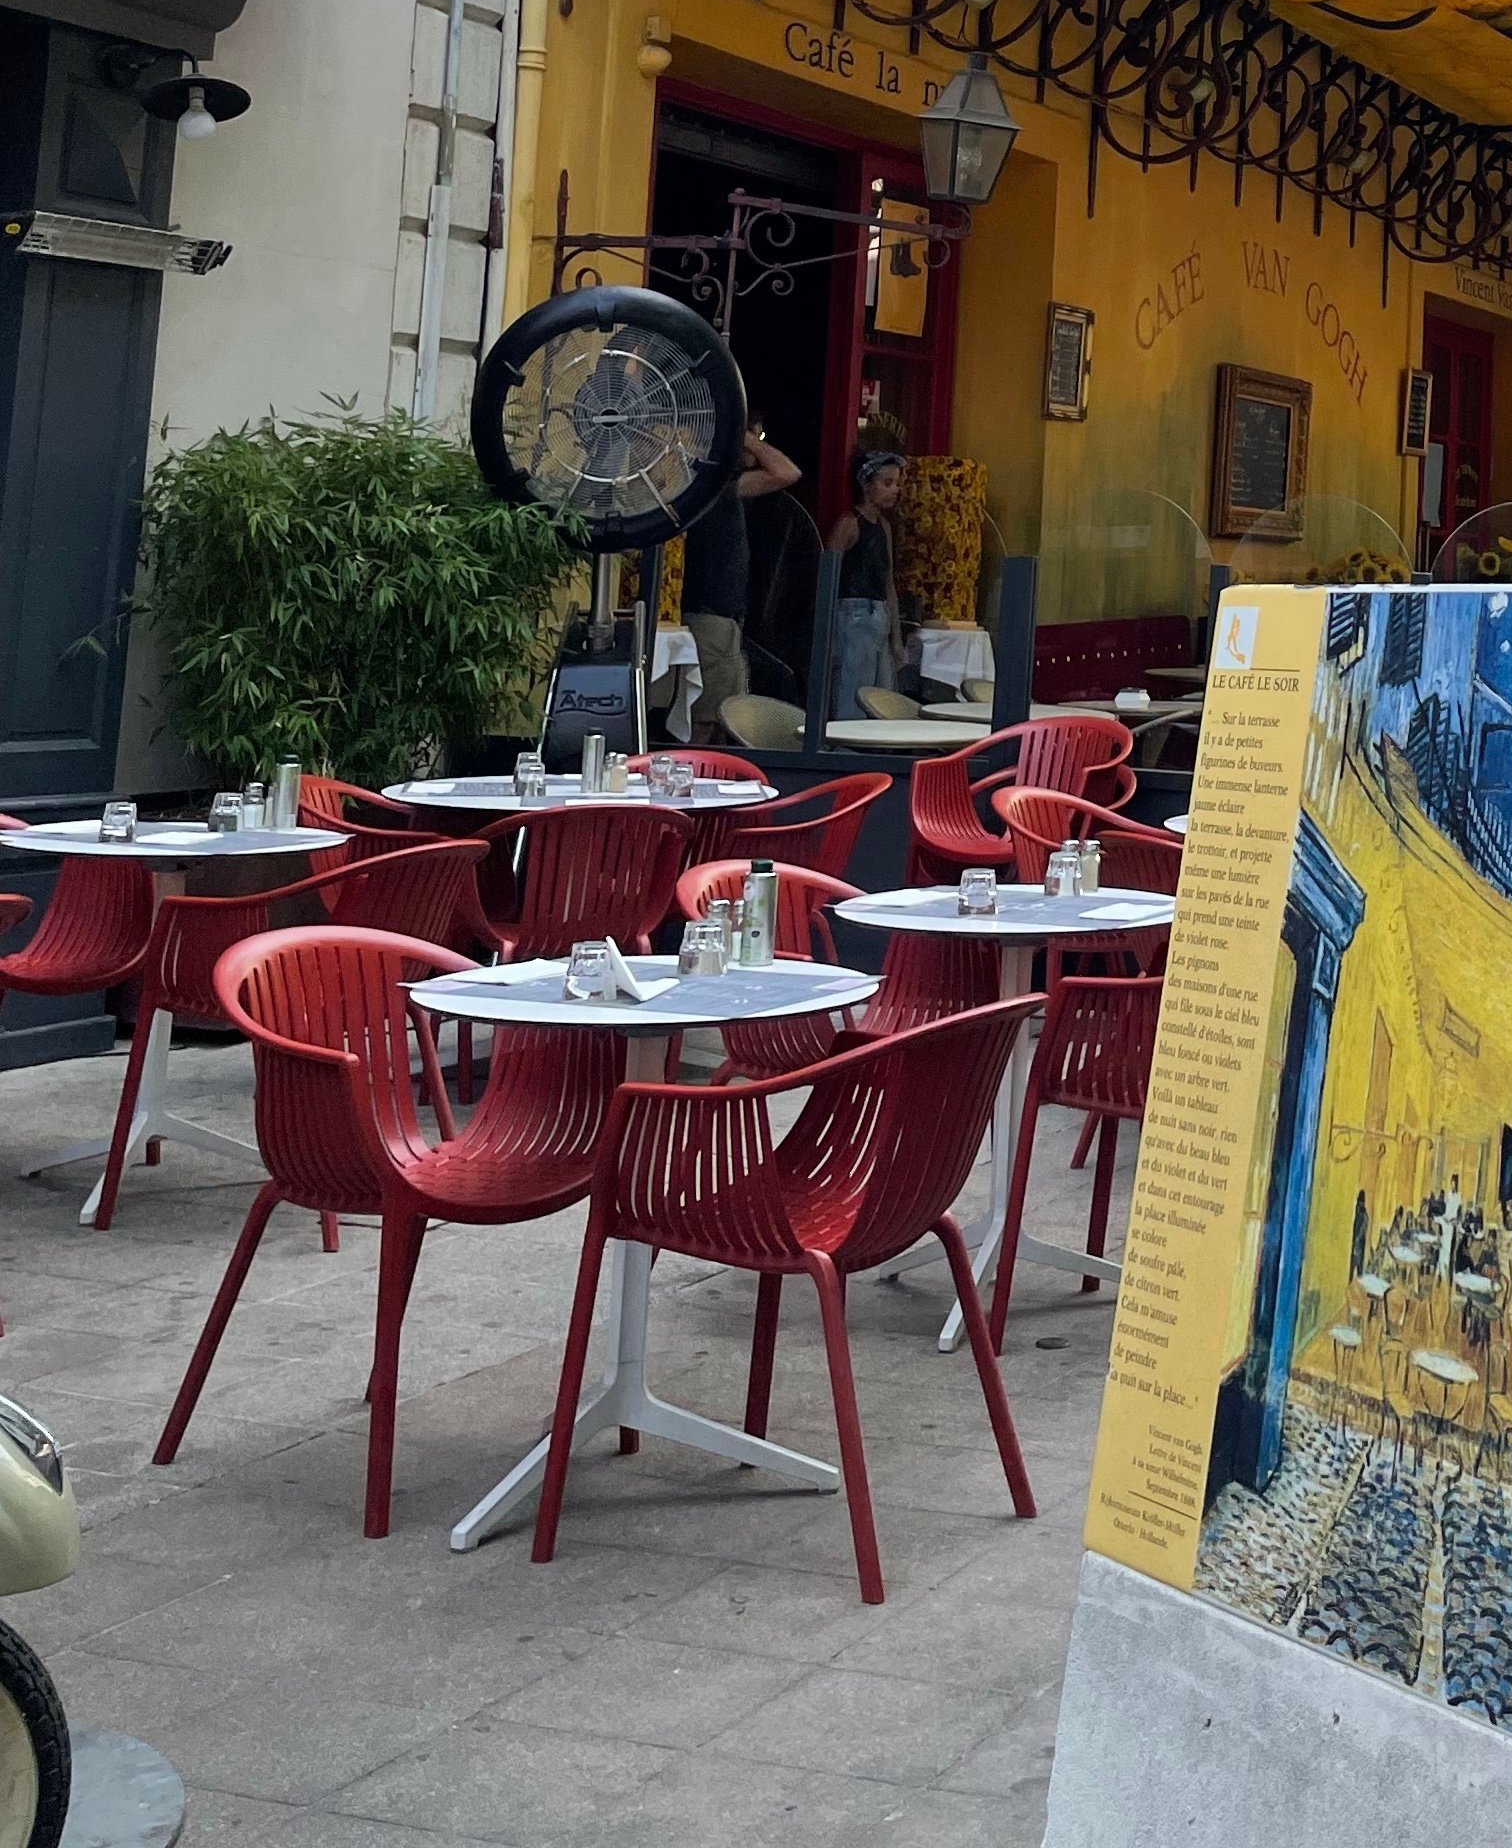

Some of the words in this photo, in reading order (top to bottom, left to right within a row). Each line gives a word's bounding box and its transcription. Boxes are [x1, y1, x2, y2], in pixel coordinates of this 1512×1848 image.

[785, 22, 855, 78] Café
[876, 51, 902, 94] la
[1455, 266, 1494, 303] Vincent
[1136, 239, 1204, 350] CAFÉ
[1241, 240, 1290, 298] VAN
[1306, 282, 1368, 407] GOGH
[1213, 675, 1226, 688] LE
[1229, 674, 1255, 690] CAFÉ
[1257, 677, 1271, 690] LE
[1274, 678, 1299, 692] SOIR
[1222, 712, 1237, 725] Sur
[1248, 716, 1280, 728] terrasse
[1225, 733, 1235, 747] de
[1236, 736, 1263, 750] petites
[1201, 752, 1236, 770] figurines
[1238, 755, 1248, 770] de
[1198, 775, 1214, 789] Une
[1254, 779, 1288, 796] lanterne
[1193, 797, 1217, 813] jaune
[1218, 799, 1245, 815] éclaire
[1239, 850, 1272, 865] projette
[1185, 864, 1209, 878] même
[1211, 869, 1227, 880] une
[1181, 888, 1195, 898] sur
[1196, 885, 1207, 901] les
[1208, 891, 1232, 905] pavés
[1234, 891, 1244, 906] de
[1255, 898, 1270, 909] rue
[1178, 908, 1192, 924] qui
[1192, 910, 1218, 925] prend
[1219, 916, 1234, 928] une
[1236, 916, 1260, 931] teinte
[1175, 928, 1185, 943] de
[1187, 931, 1209, 946] violet
[1170, 951, 1186, 968] Les
[1186, 956, 1219, 972] pignons
[1168, 972, 1182, 989] des
[1184, 978, 1217, 994] maisons
[1243, 991, 1258, 1002] rue
[1165, 997, 1179, 1013] qui
[1180, 997, 1193, 1014] file
[1195, 1005, 1213, 1018] sous
[1225, 1007, 1240, 1023] ciel
[1242, 1008, 1260, 1027] bleu
[1162, 1022, 1197, 1038] constellé
[1237, 1037, 1256, 1050] sont
[1158, 1040, 1176, 1057] bleu
[1178, 1044, 1201, 1062] foncé
[1202, 1054, 1213, 1065] ou
[1215, 1053, 1242, 1071] violets
[1155, 1067, 1173, 1080] avec
[1175, 1072, 1186, 1083] un
[1188, 1071, 1210, 1088] arbre
[1153, 1086, 1173, 1104] Voilà
[1175, 1095, 1186, 1107] un
[1188, 1095, 1219, 1114] tableau
[1148, 1108, 1159, 1124] de
[1160, 1114, 1177, 1128] nuit
[1179, 1120, 1196, 1134] sans
[1220, 1127, 1238, 1144] rien
[1177, 1139, 1188, 1156] du
[1190, 1141, 1210, 1161] beau
[1212, 1147, 1230, 1166] bleu
[1151, 1157, 1162, 1173] du
[1165, 1162, 1186, 1180] violet
[1198, 1169, 1210, 1186] du
[1212, 1176, 1228, 1191] vert
[1138, 1181, 1146, 1193] et
[1148, 1180, 1167, 1198] dans
[1169, 1190, 1181, 1203] cet
[1183, 1194, 1225, 1217] entourage
[1143, 1204, 1166, 1223] place
[1167, 1210, 1206, 1235] illuminée
[1132, 1228, 1140, 1240] se
[1142, 1228, 1167, 1248] colore
[1128, 1247, 1138, 1263] de
[1140, 1254, 1166, 1272] soufre
[1125, 1270, 1135, 1287] de
[1136, 1276, 1161, 1296] citron
[1122, 1294, 1139, 1313] Cela
[1114, 1342, 1124, 1358] de
[1125, 1350, 1157, 1370] peindre
[1120, 1373, 1137, 1388] nuit
[1138, 1379, 1153, 1393] sur
